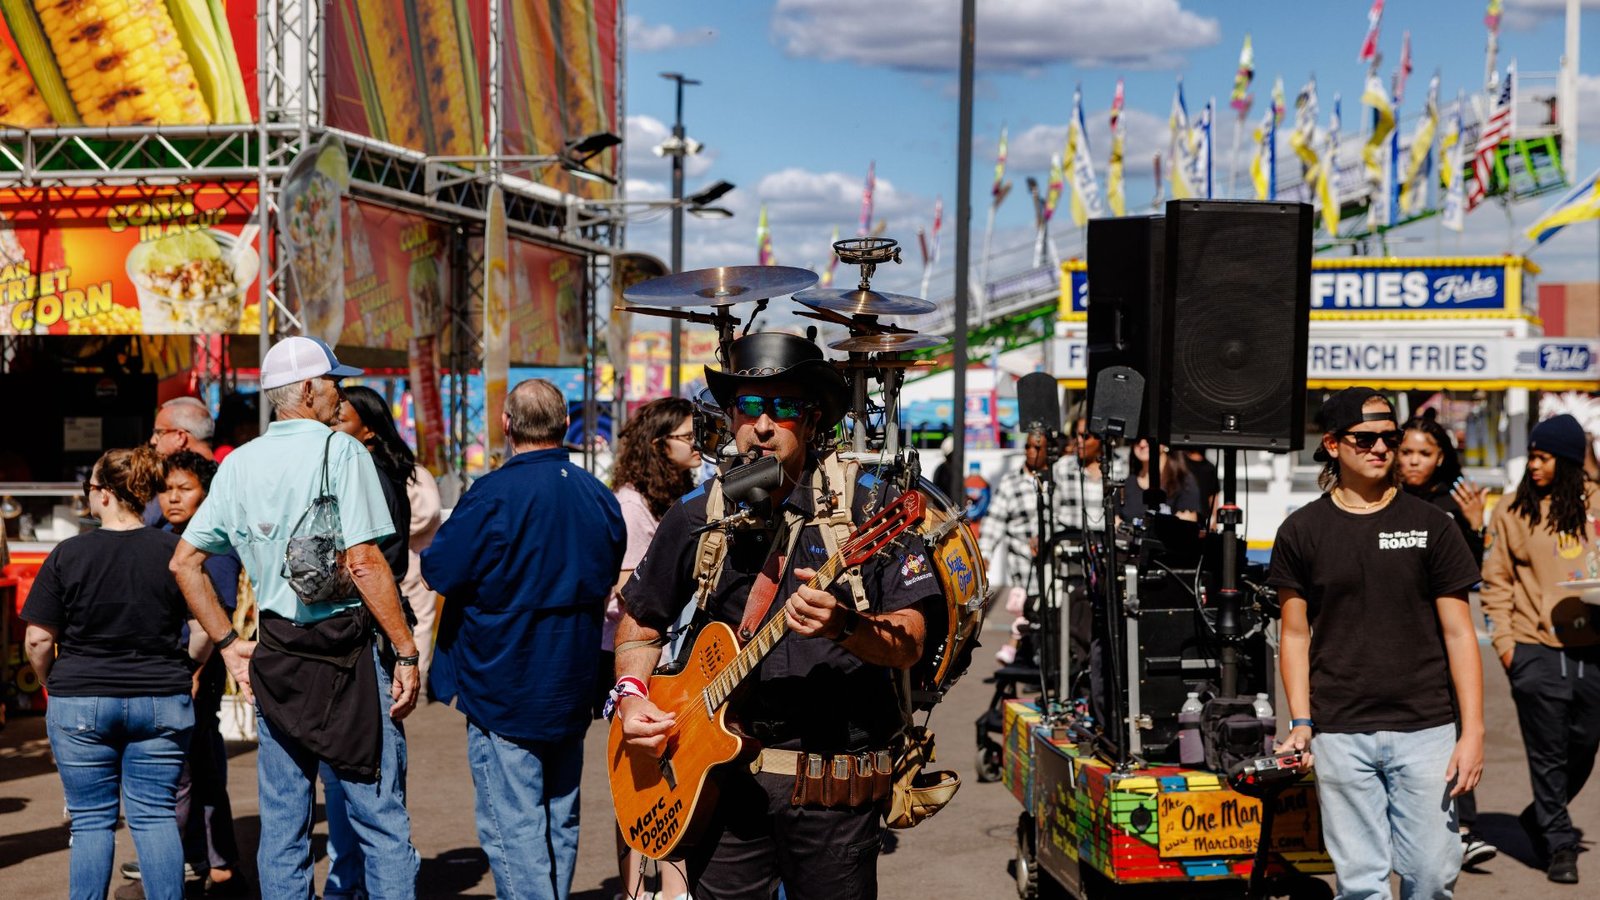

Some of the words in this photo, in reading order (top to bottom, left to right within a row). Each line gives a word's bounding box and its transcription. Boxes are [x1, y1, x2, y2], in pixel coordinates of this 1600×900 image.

[11, 280, 112, 331] CORN
[1310, 270, 1430, 308] FRIES
[1409, 344, 1487, 371] FRIES
[1378, 537, 1427, 549] ROADE
[629, 796, 666, 842] Marc
[640, 798, 683, 850] Dobson
[1161, 798, 1184, 818] The
[1181, 804, 1218, 833] One
[1221, 798, 1263, 829] Man
[652, 817, 679, 854] .com
[1194, 835, 1307, 852] MarcDobs.com
